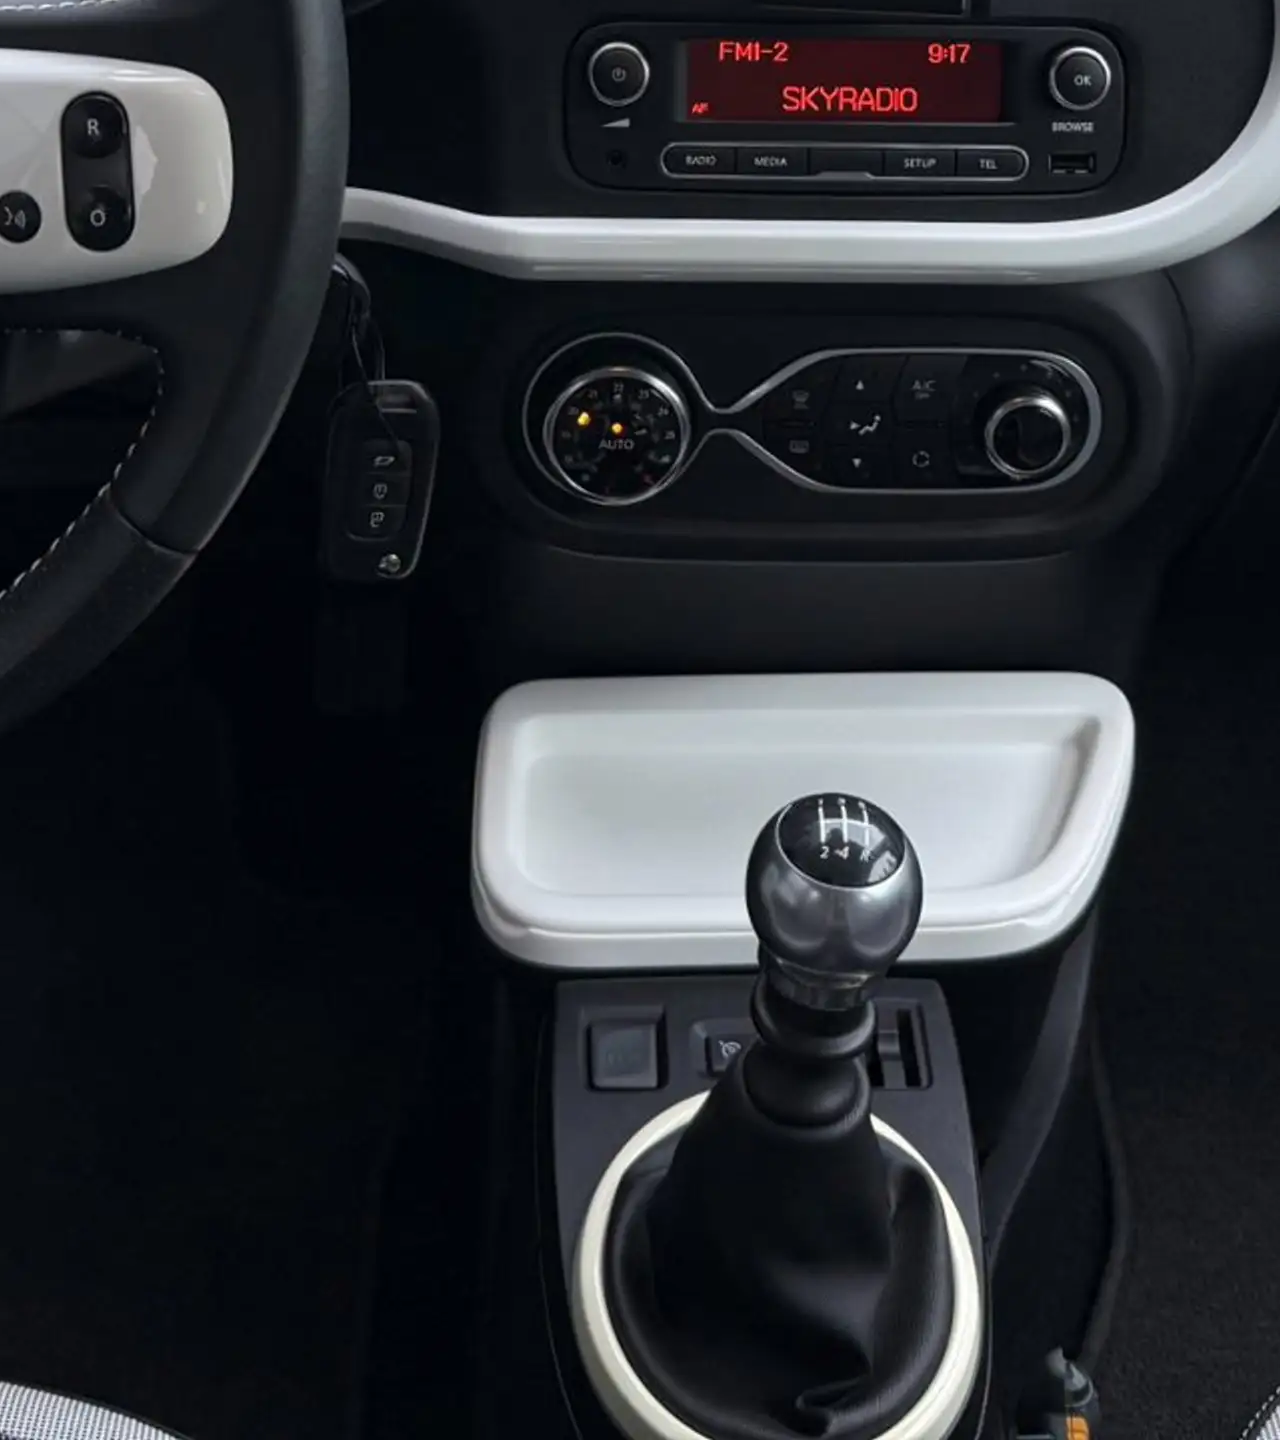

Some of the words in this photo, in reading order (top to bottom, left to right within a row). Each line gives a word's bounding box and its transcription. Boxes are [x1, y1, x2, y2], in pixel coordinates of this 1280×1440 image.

[928, 42, 971, 64] 9:17
[1073, 74, 1092, 87] OK
[782, 85, 918, 112] SKYRADIO
[86, 117, 100, 136] R
[1051, 121, 1094, 133] BROWSE
[685, 154, 718, 166] RADIO
[753, 156, 788, 167] MEDIA
[903, 157, 937, 169] SETUP
[979, 158, 998, 170] TEL
[598, 438, 636, 451] AUTO
[819, 845, 831, 859] 2
